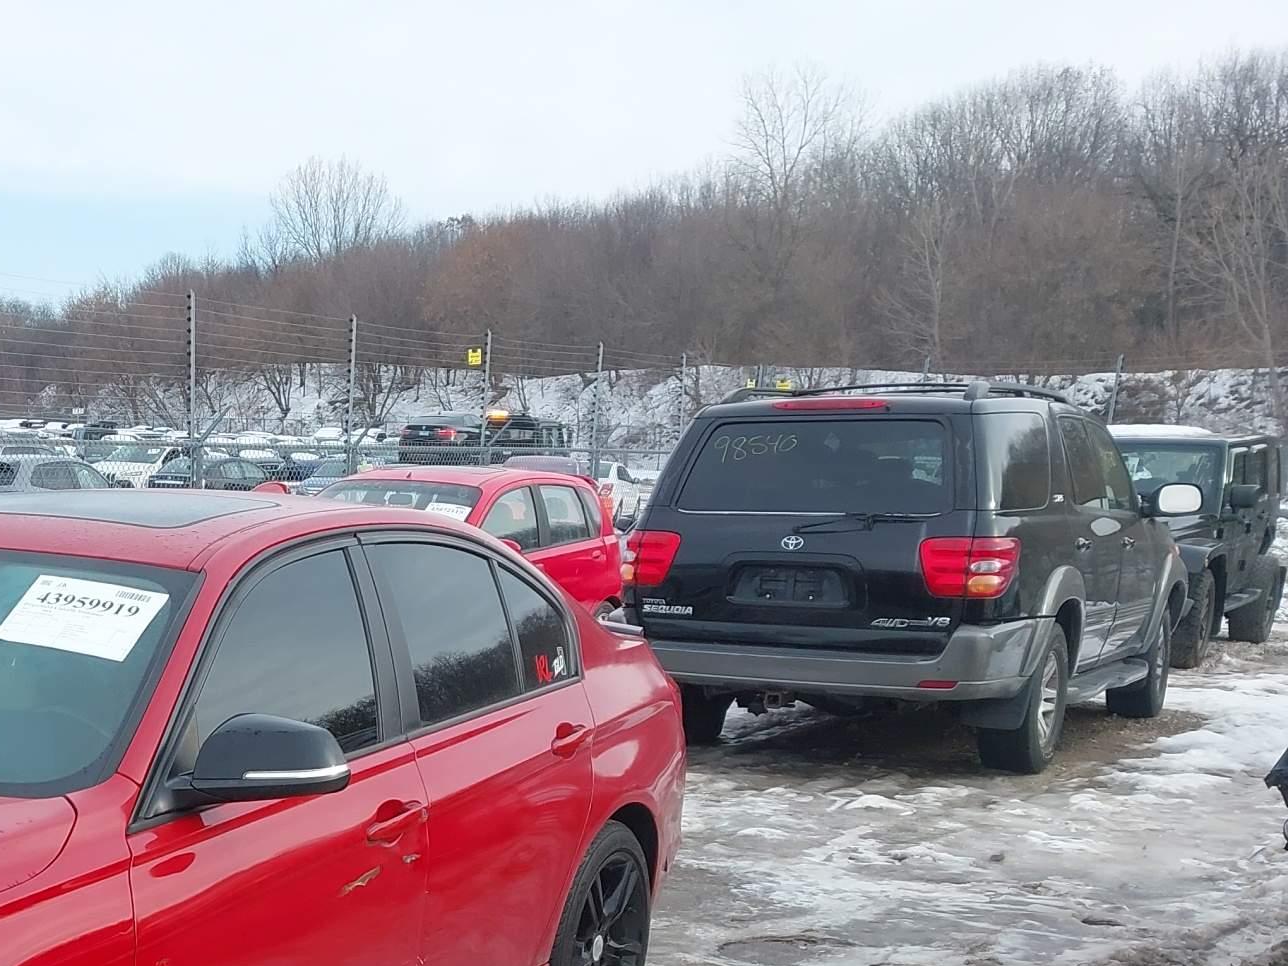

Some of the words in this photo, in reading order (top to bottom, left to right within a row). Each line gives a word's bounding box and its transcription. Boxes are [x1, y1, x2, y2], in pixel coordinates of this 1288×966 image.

[713, 433, 798, 464] 98540
[36, 591, 141, 618] 43959919
[642, 604, 693, 616] SEQUOIA
[927, 616, 951, 627] V8
